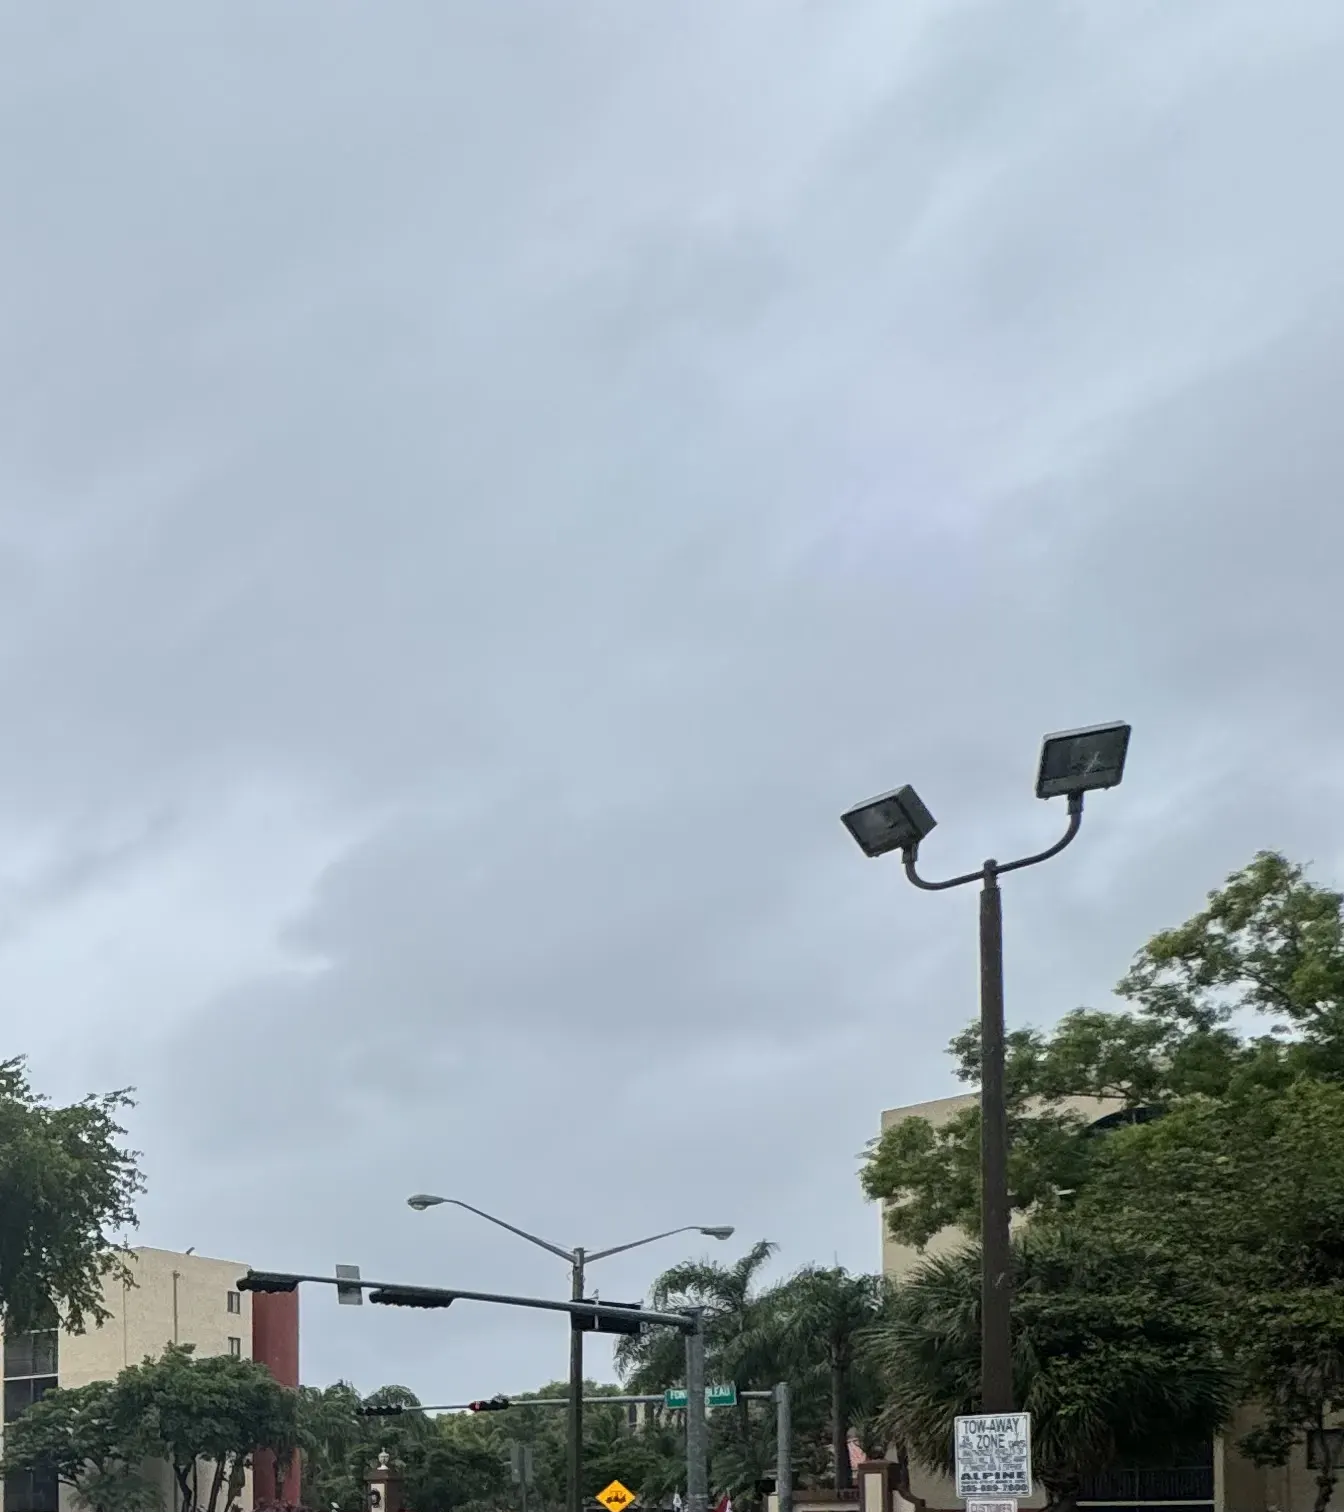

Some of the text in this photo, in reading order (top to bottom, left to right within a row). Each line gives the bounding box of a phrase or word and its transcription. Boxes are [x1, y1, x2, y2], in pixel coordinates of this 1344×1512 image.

[963, 1418, 1019, 1434] TOW-AWAY
[976, 1433, 1005, 1449] ZONE
[961, 1472, 1026, 1480] ALPINE
